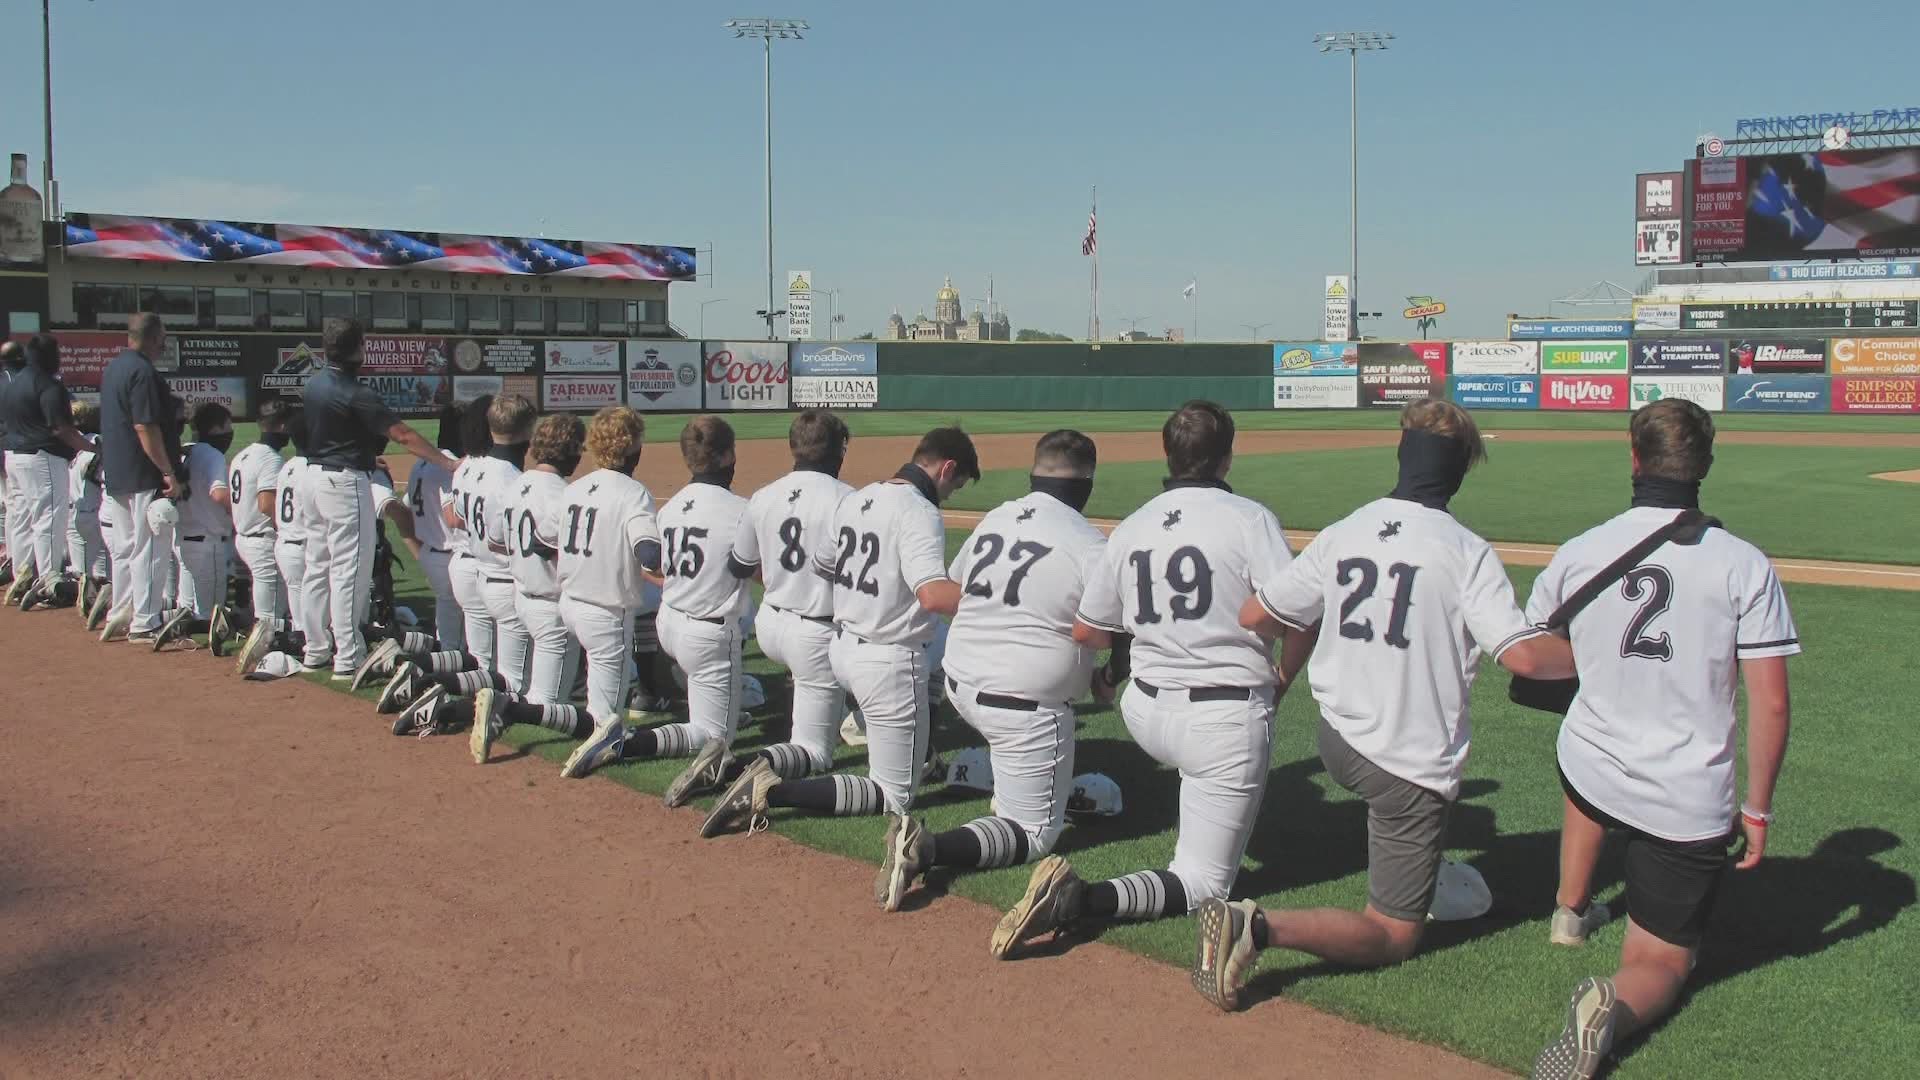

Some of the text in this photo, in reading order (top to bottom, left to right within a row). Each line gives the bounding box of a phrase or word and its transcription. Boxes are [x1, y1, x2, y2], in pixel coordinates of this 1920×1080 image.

[1737, 107, 1920, 133] PRINCIPAL PAR
[1696, 193, 1715, 202] THIS
[1696, 202, 1712, 211] FOR
[1713, 237, 1743, 245] MILLION
[1792, 265, 1887, 278] BUD LIGHT BLEACHERS
[790, 317, 810, 325] Bank
[1690, 311, 1724, 319] VISITORS
[1327, 321, 1346, 329] Bank
[1696, 320, 1718, 329] HOME
[183, 340, 239, 348] ATTORNEYS
[366, 340, 426, 351] RAND VIEW
[802, 350, 865, 362] broadlawns
[1552, 350, 1618, 364] SUBWAY
[1874, 351, 1916, 361] Choice
[705, 350, 789, 384] Coors
[1363, 365, 1387, 374] SAVE
[169, 379, 219, 392] LOUIE'S
[264, 376, 298, 386] PRAIRIE
[1363, 375, 1431, 384] SAVE ENERGY!
[550, 383, 616, 395] FAREWAY
[825, 380, 875, 393] LUANA
[1457, 382, 1506, 392] SUPERCUTS
[1690, 383, 1720, 392] IOWA
[1846, 380, 1916, 392] SIMPSON
[721, 385, 775, 401] LIGHT
[1756, 391, 1816, 399] WEST BEND
[1845, 391, 1916, 403] COLLEGE
[186, 394, 232, 405] Covering
[231, 469, 241, 505] 9
[412, 478, 425, 517] 4
[281, 486, 294, 523] 6
[504, 506, 536, 558] 10
[563, 504, 599, 557] 11
[778, 516, 806, 573] 8
[663, 526, 709, 579] 15
[834, 526, 880, 597] 22
[965, 533, 1054, 607] 27
[1129, 545, 1215, 624] 19
[1336, 556, 1424, 649] 21
[1620, 563, 1674, 662] 2
[416, 709, 429, 726] N
[954, 764, 969, 783] R
